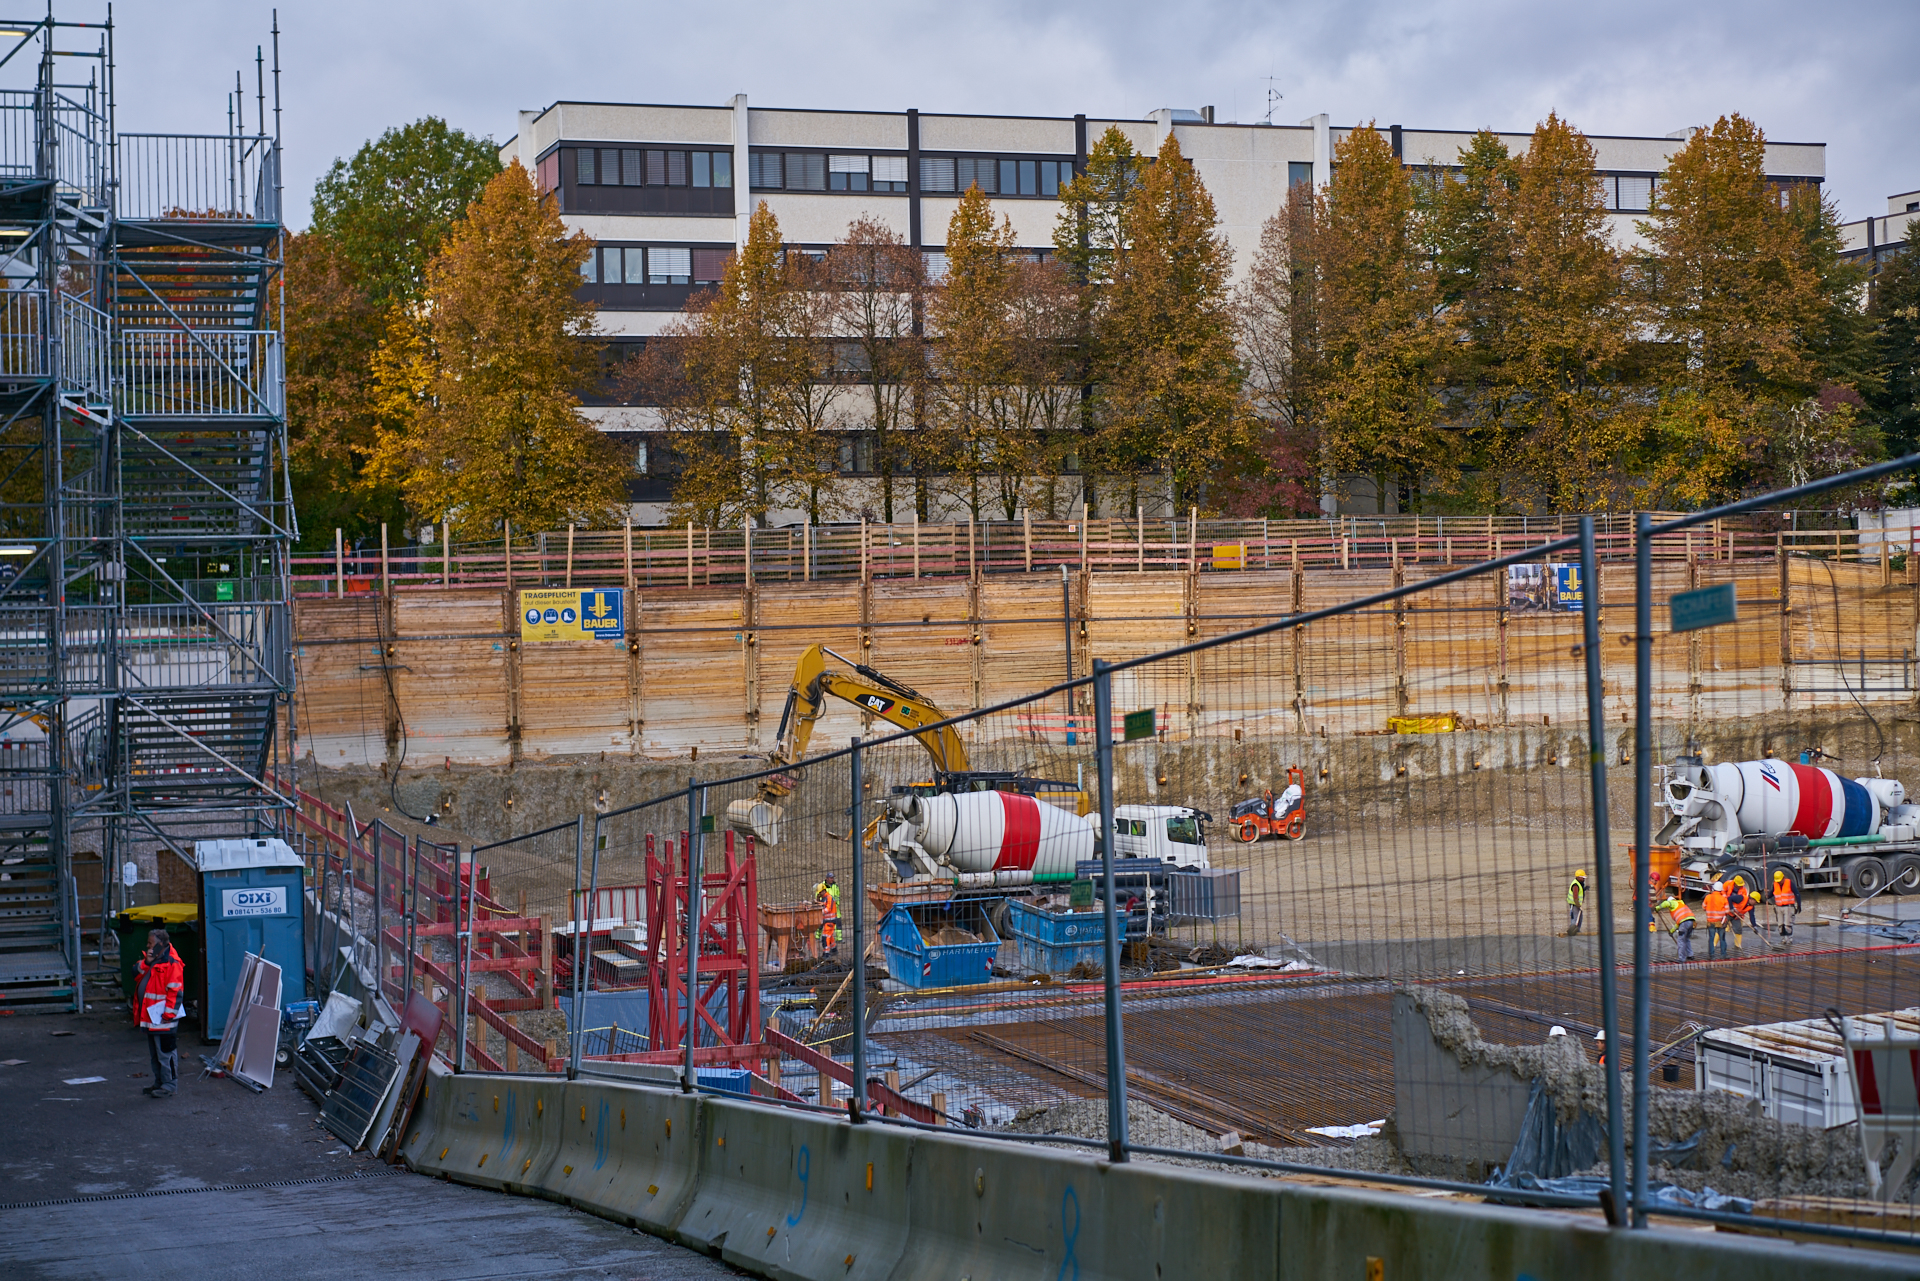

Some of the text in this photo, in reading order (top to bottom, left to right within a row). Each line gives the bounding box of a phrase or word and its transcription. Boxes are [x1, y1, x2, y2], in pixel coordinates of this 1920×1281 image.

[524, 591, 577, 599] TRAGEPFLICHT
[1560, 591, 1584, 601] BAUE
[583, 618, 618, 629] BAUER
[867, 695, 886, 712] CAT
[38, 718, 49, 726] JC
[234, 908, 254, 916] 08141
[942, 946, 998, 956] HARTMEIER
